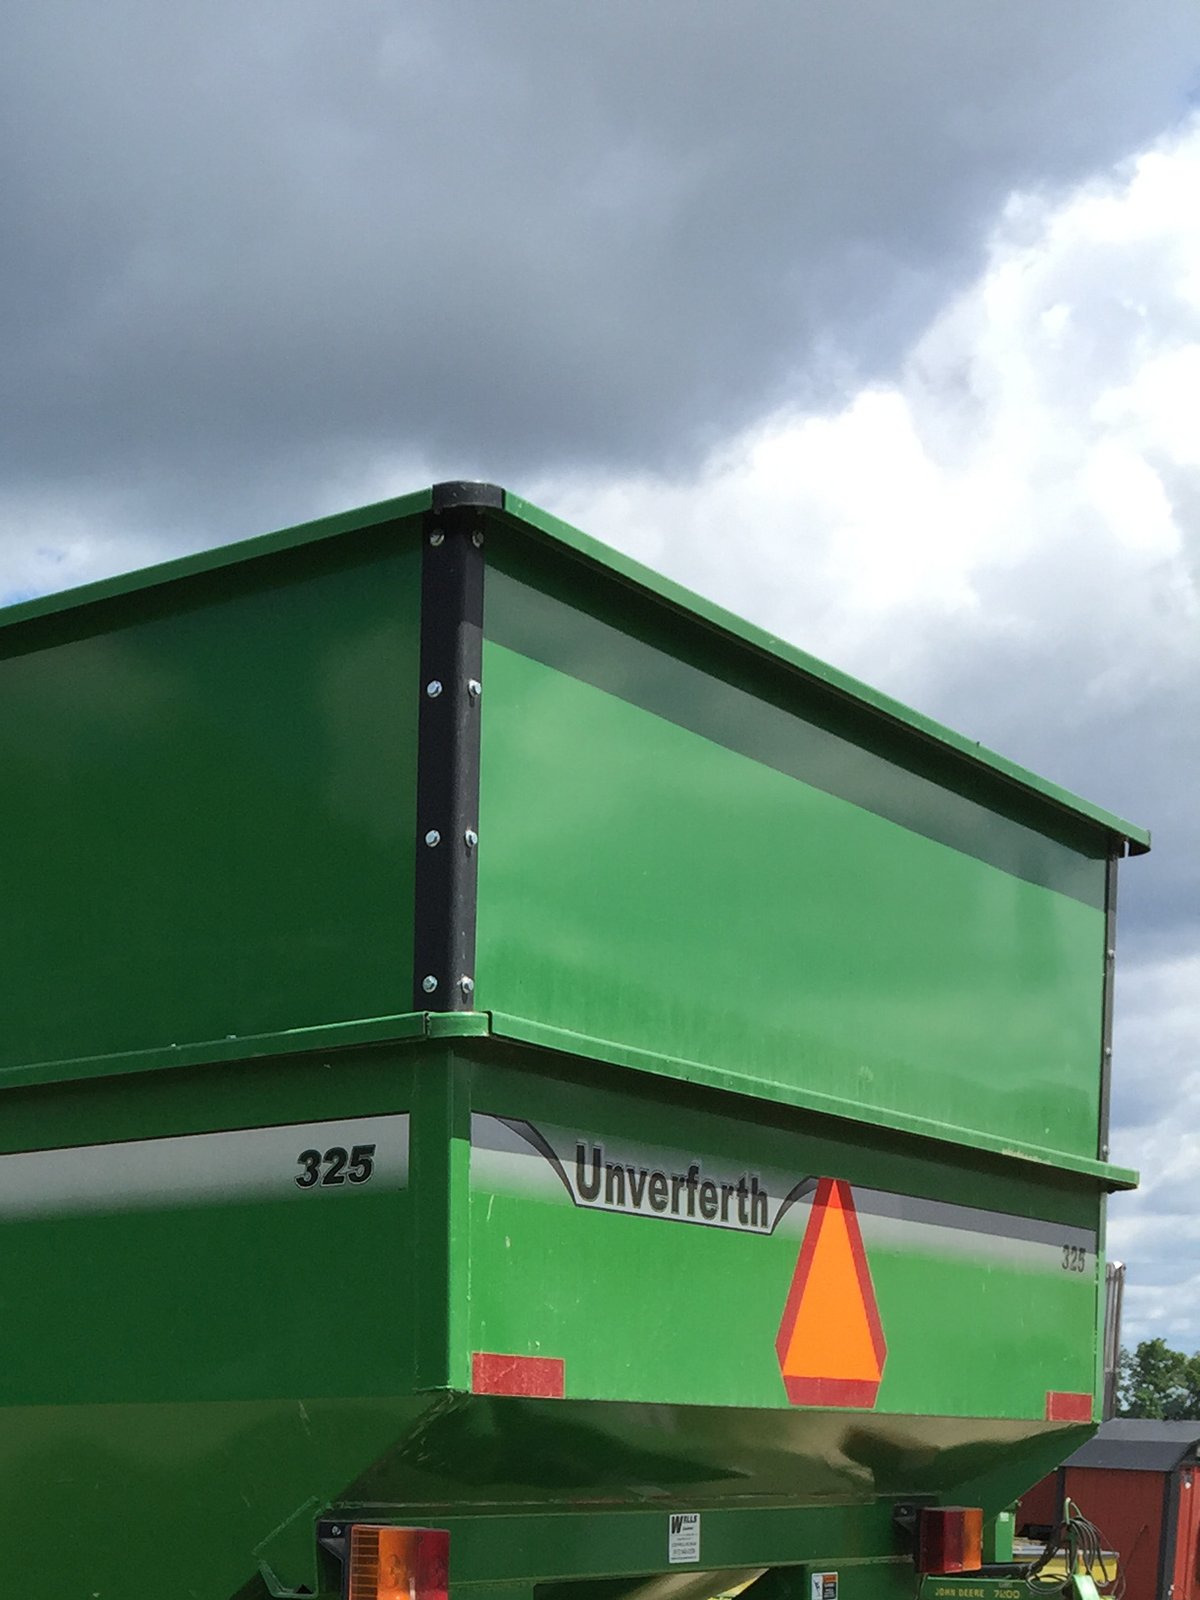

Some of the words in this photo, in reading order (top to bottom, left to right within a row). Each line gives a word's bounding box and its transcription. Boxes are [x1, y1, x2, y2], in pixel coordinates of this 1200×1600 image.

[295, 1144, 377, 1188] 325
[575, 1140, 769, 1229] Unverferth
[1062, 1244, 1086, 1273] 325
[935, 1587, 955, 1597] JOHN
[958, 1588, 985, 1598] DEERE
